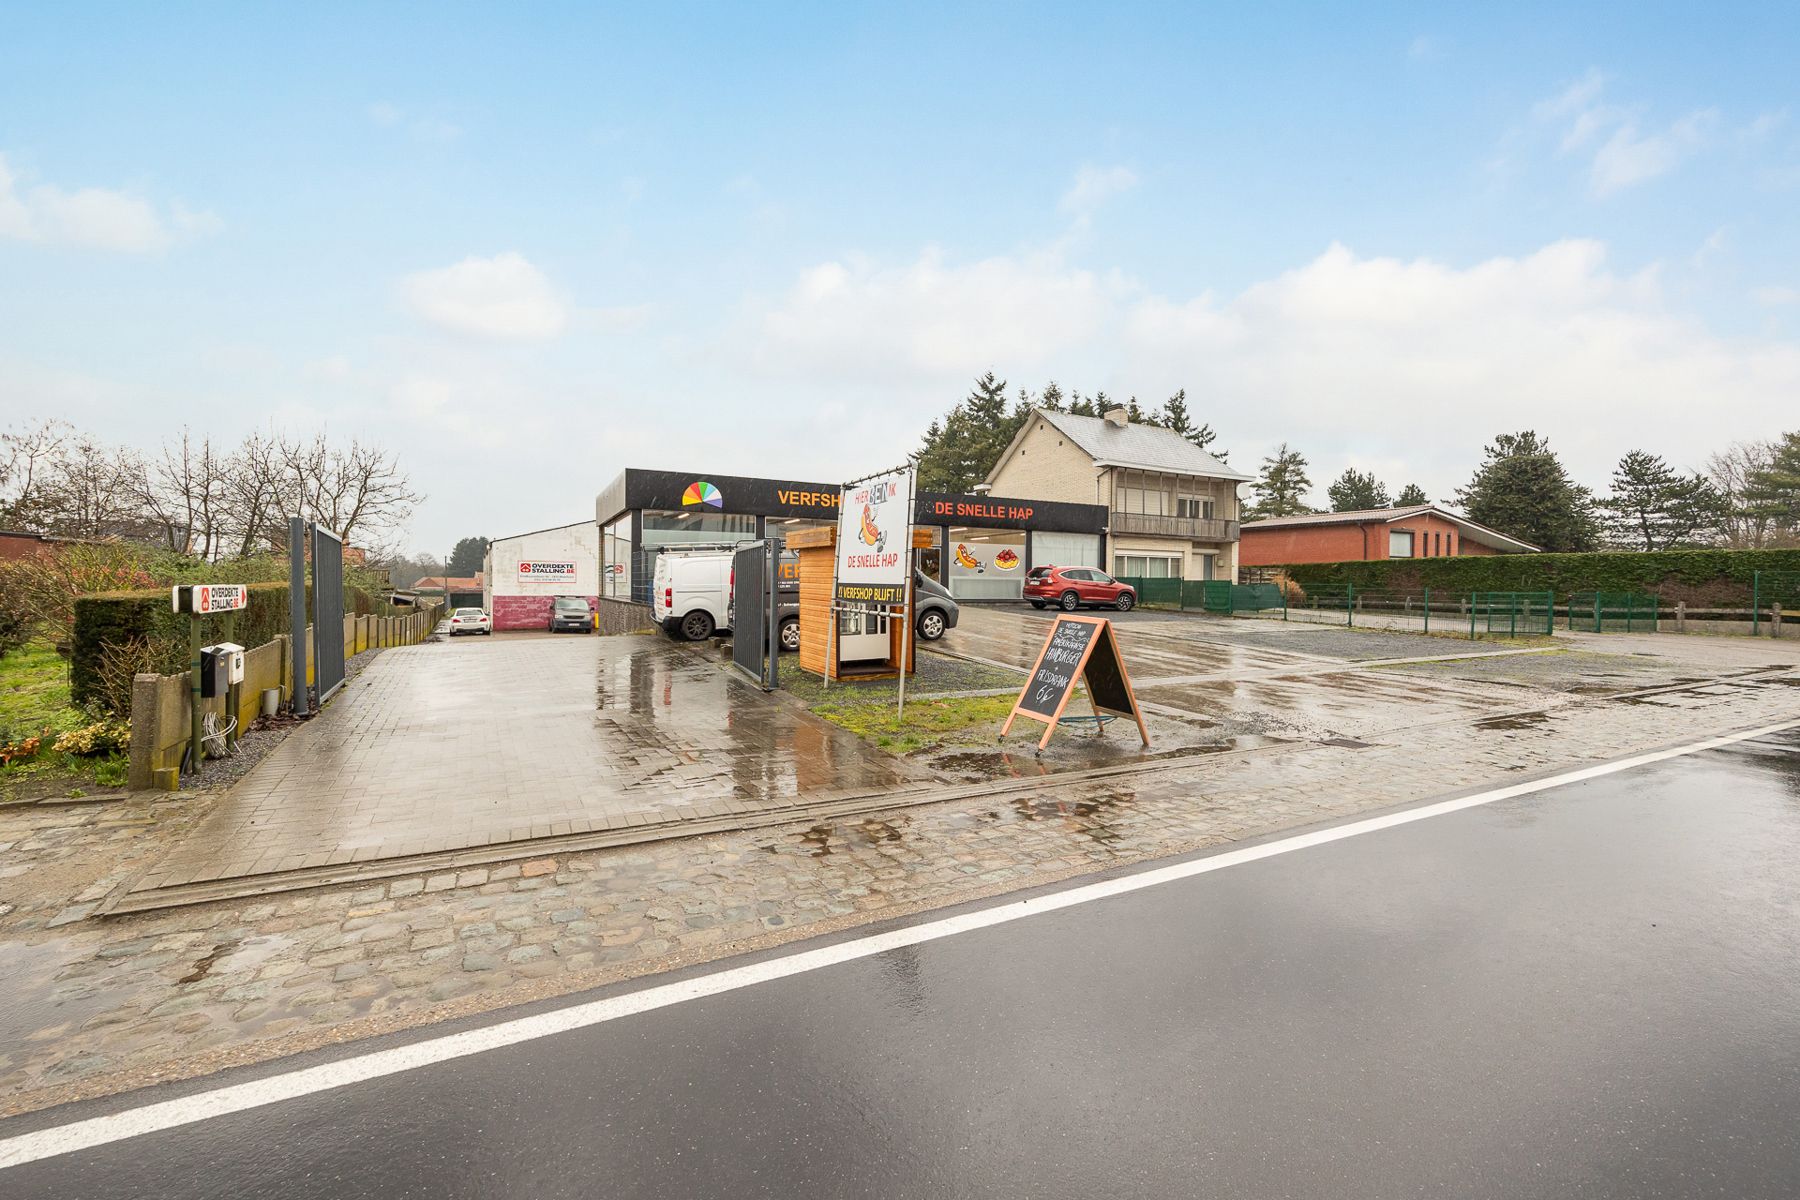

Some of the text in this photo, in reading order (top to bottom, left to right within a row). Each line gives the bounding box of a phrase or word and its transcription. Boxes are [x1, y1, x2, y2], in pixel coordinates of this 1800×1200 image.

[855, 482, 897, 504] HIER BEN IK
[935, 502, 1033, 519] DE SNELLE HAP
[848, 553, 897, 568] DE SNELLE HAP
[211, 587, 238, 598] OVERDEKTE
[843, 587, 873, 600] VERFSHOP
